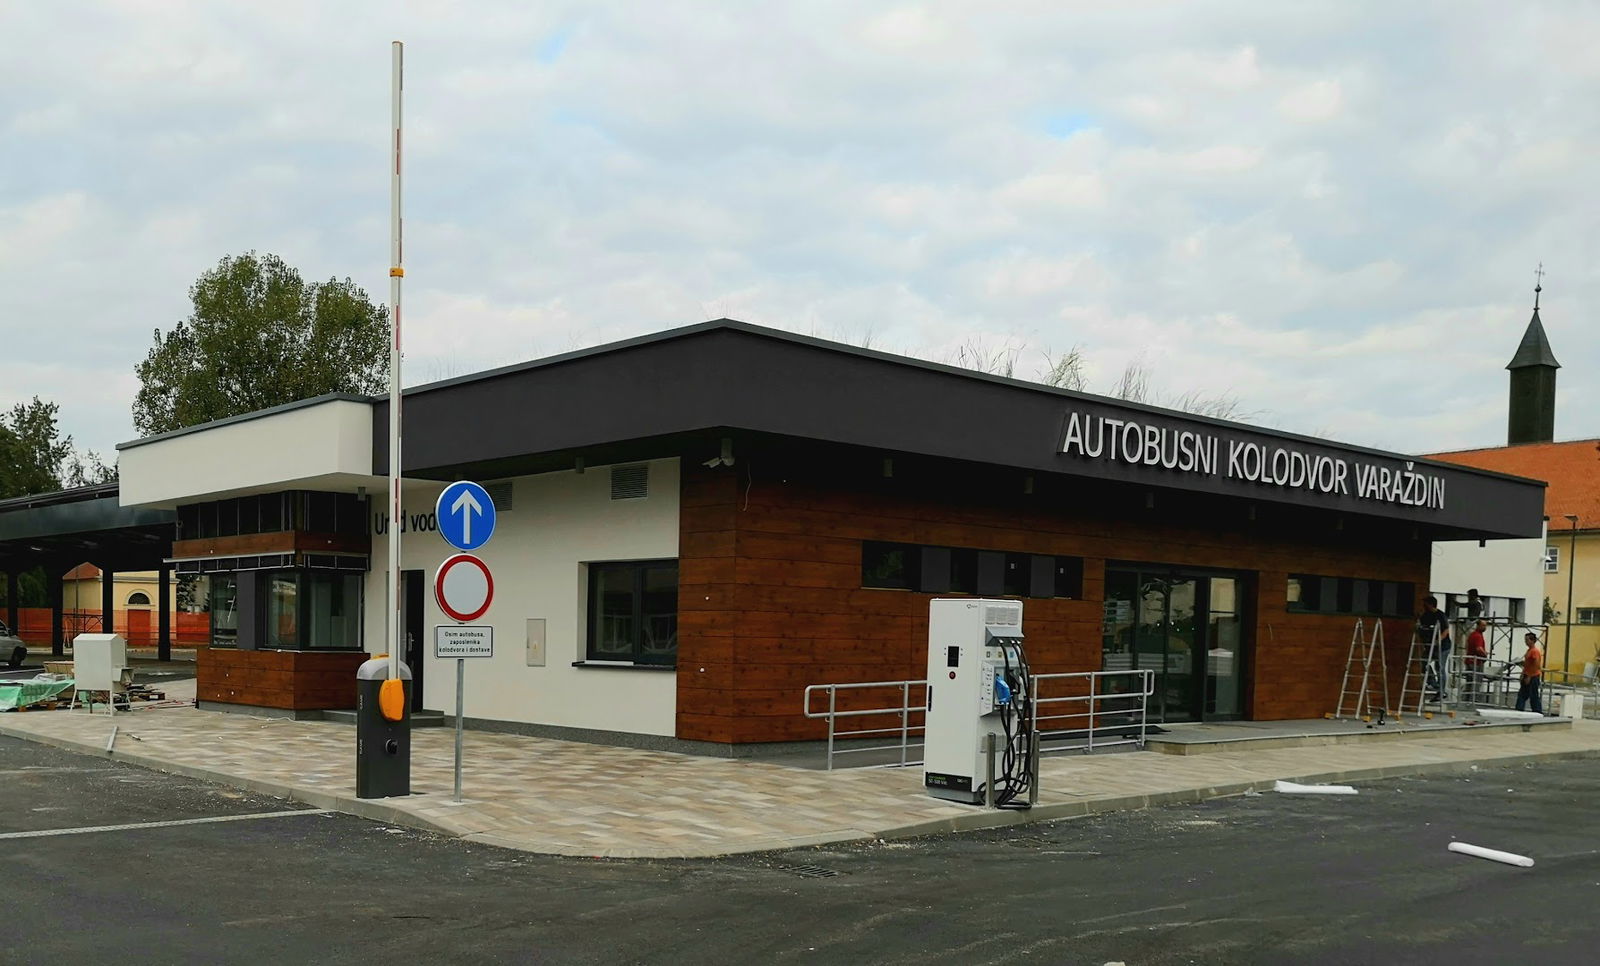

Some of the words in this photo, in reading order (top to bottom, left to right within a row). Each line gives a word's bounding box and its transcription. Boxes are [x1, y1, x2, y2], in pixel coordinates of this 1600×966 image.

[1062, 412, 1218, 475] AUTOBUSNI
[1228, 440, 1348, 494] KOLODVOR
[1355, 461, 1445, 509] VARAŽDIN
[374, 509, 407, 535] Urd
